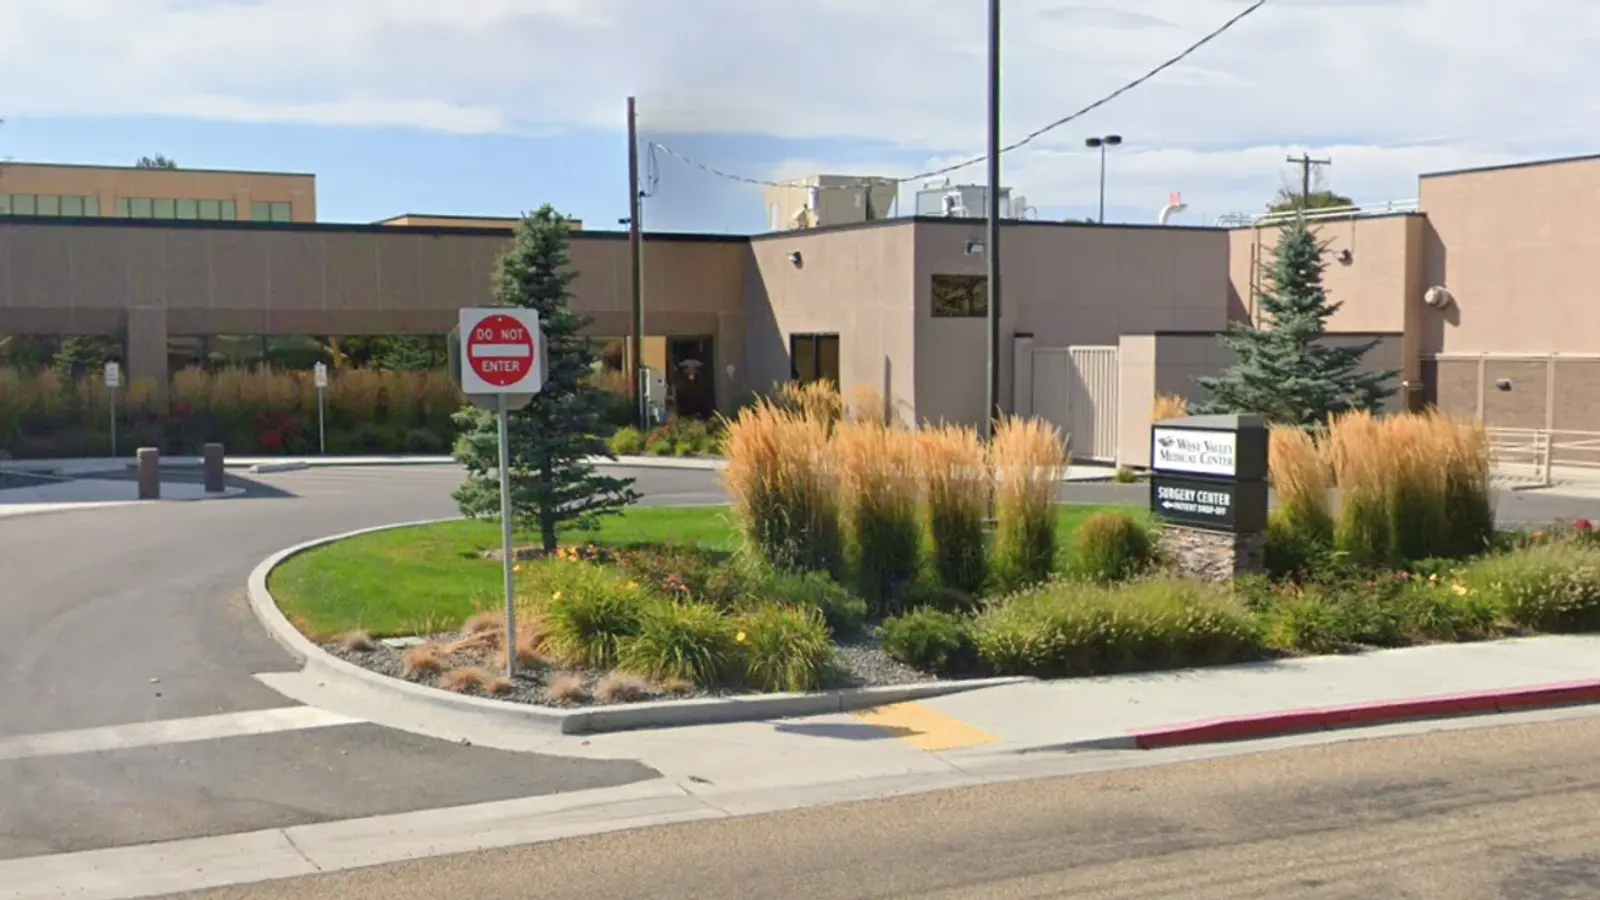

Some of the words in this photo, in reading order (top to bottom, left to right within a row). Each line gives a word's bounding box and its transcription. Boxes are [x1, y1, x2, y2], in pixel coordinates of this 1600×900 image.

[476, 328, 493, 340] DO
[501, 328, 524, 340] NOT
[482, 360, 520, 372] ENTER
[1176, 438, 1201, 452] WEST
[1203, 440, 1234, 455] VALLEY
[1159, 449, 1197, 464] MEDICAL
[1199, 452, 1235, 466] CENTER
[1157, 486, 1196, 502] SURGERY
[1196, 490, 1231, 506] CENTER
[1173, 501, 1197, 512] PATIENT
